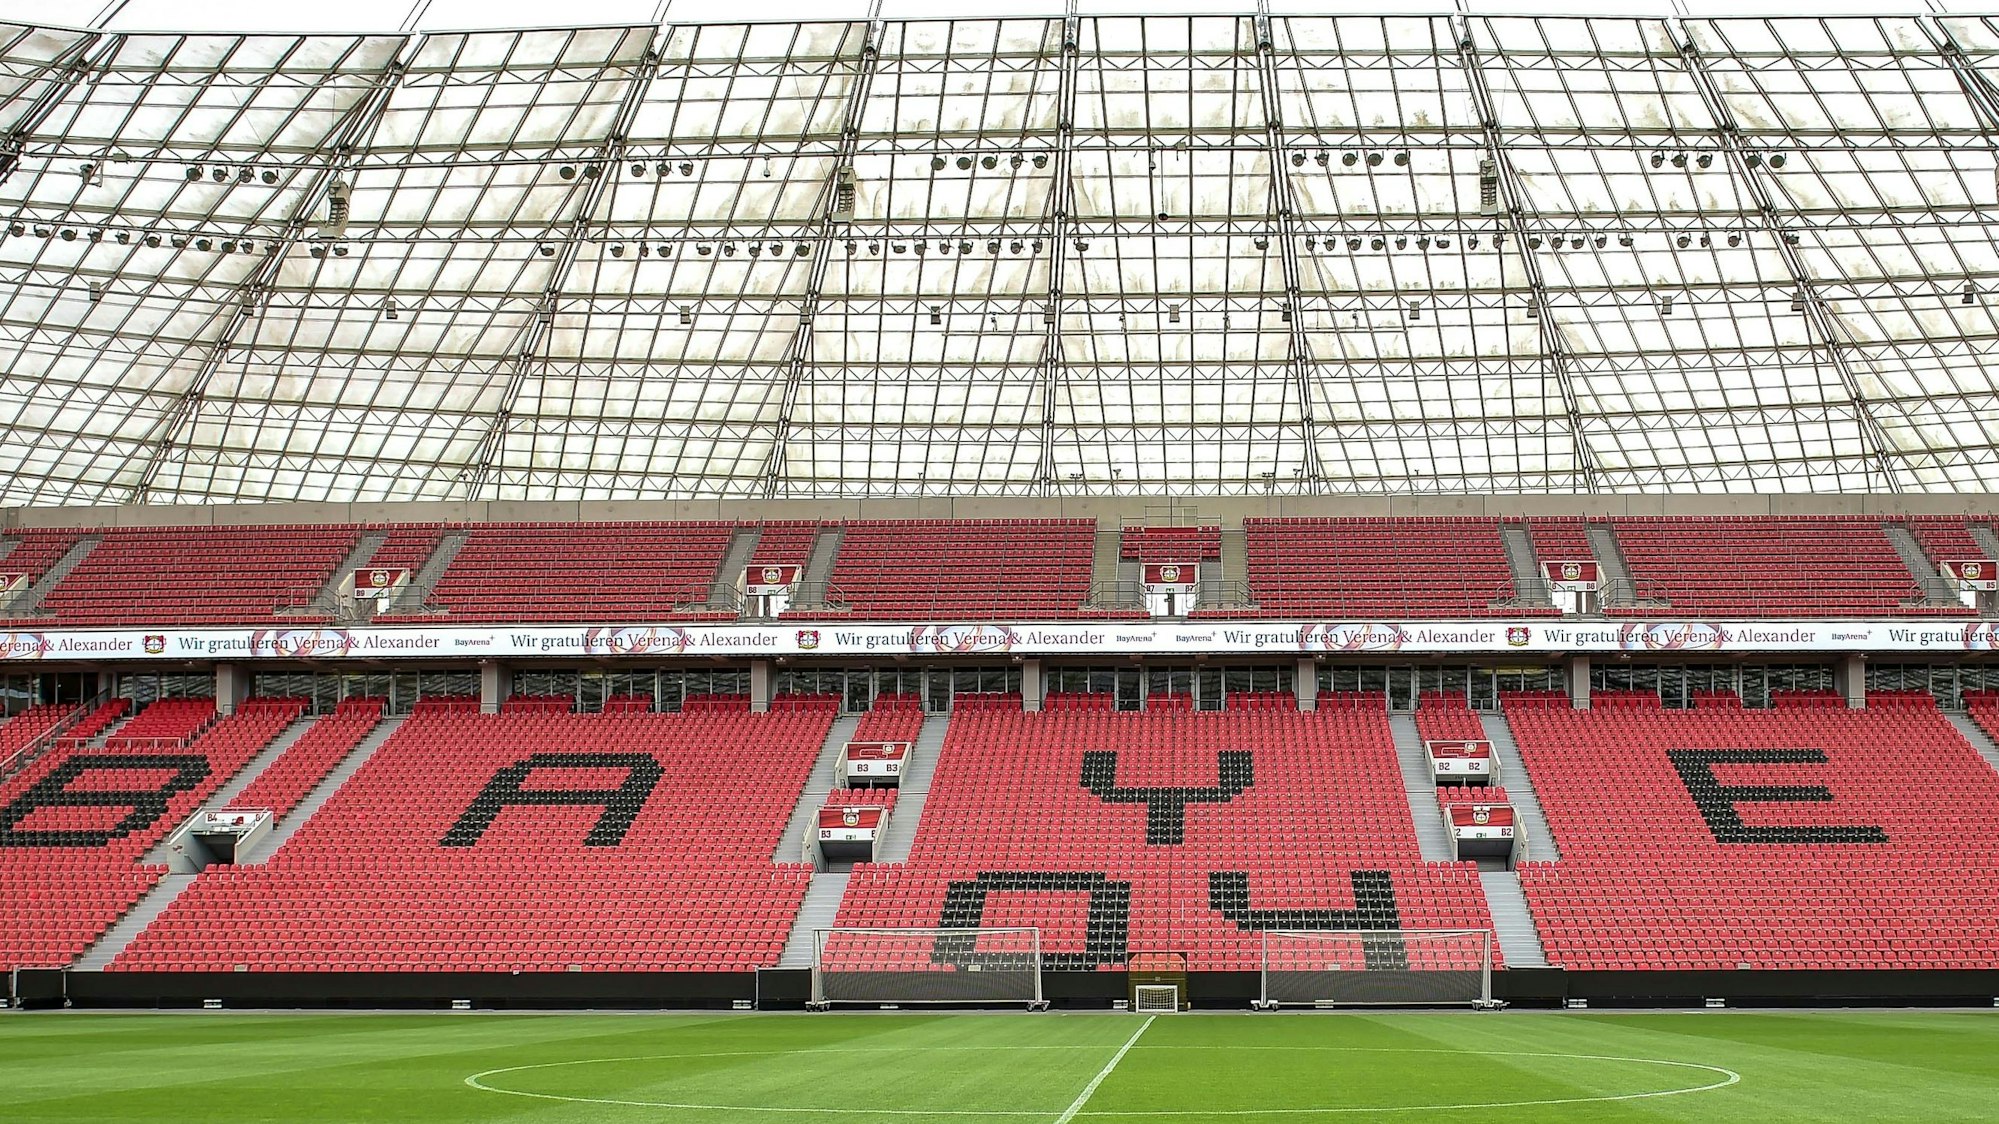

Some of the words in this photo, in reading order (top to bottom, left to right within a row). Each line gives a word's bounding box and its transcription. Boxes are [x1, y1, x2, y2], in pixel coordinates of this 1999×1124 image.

[510, 634, 538, 647] Wir
[541, 633, 624, 650] gratulieren
[627, 633, 681, 647] Verena
[684, 634, 696, 647] &
[699, 632, 778, 646] Alexander
[835, 632, 863, 646] Wir
[866, 631, 949, 649] gratulieren
[953, 631, 1007, 645] Verena
[1011, 631, 1022, 645] &
[1026, 631, 1105, 644] Alexander
[1223, 630, 1251, 644] Wir
[1255, 629, 1338, 647] gratulieren
[1343, 630, 1396, 643] Verena
[1401, 630, 1412, 643] &
[1416, 629, 1496, 643] Alexander
[1544, 629, 1572, 643] Wir
[1575, 628, 1659, 646] gratulieren
[1663, 629, 1717, 643] Verena
[1721, 629, 1733, 642] &
[1737, 628, 1816, 642] Alexander
[1889, 629, 1916, 642] Wir
[44, 639, 54, 651] &
[58, 637, 133, 651] Alexander
[178, 636, 205, 650] Wir
[208, 636, 288, 653] gratulieren
[293, 636, 344, 649] Verena
[348, 635, 360, 649] &
[363, 635, 440, 649] Alexander
[857, 763, 869, 772] B3
[886, 763, 898, 772] B3
[1438, 762, 1450, 771] B2
[1468, 762, 1480, 771] B2
[207, 813, 218, 822] B4
[821, 830, 831, 838] B3
[1501, 828, 1512, 836] B2
